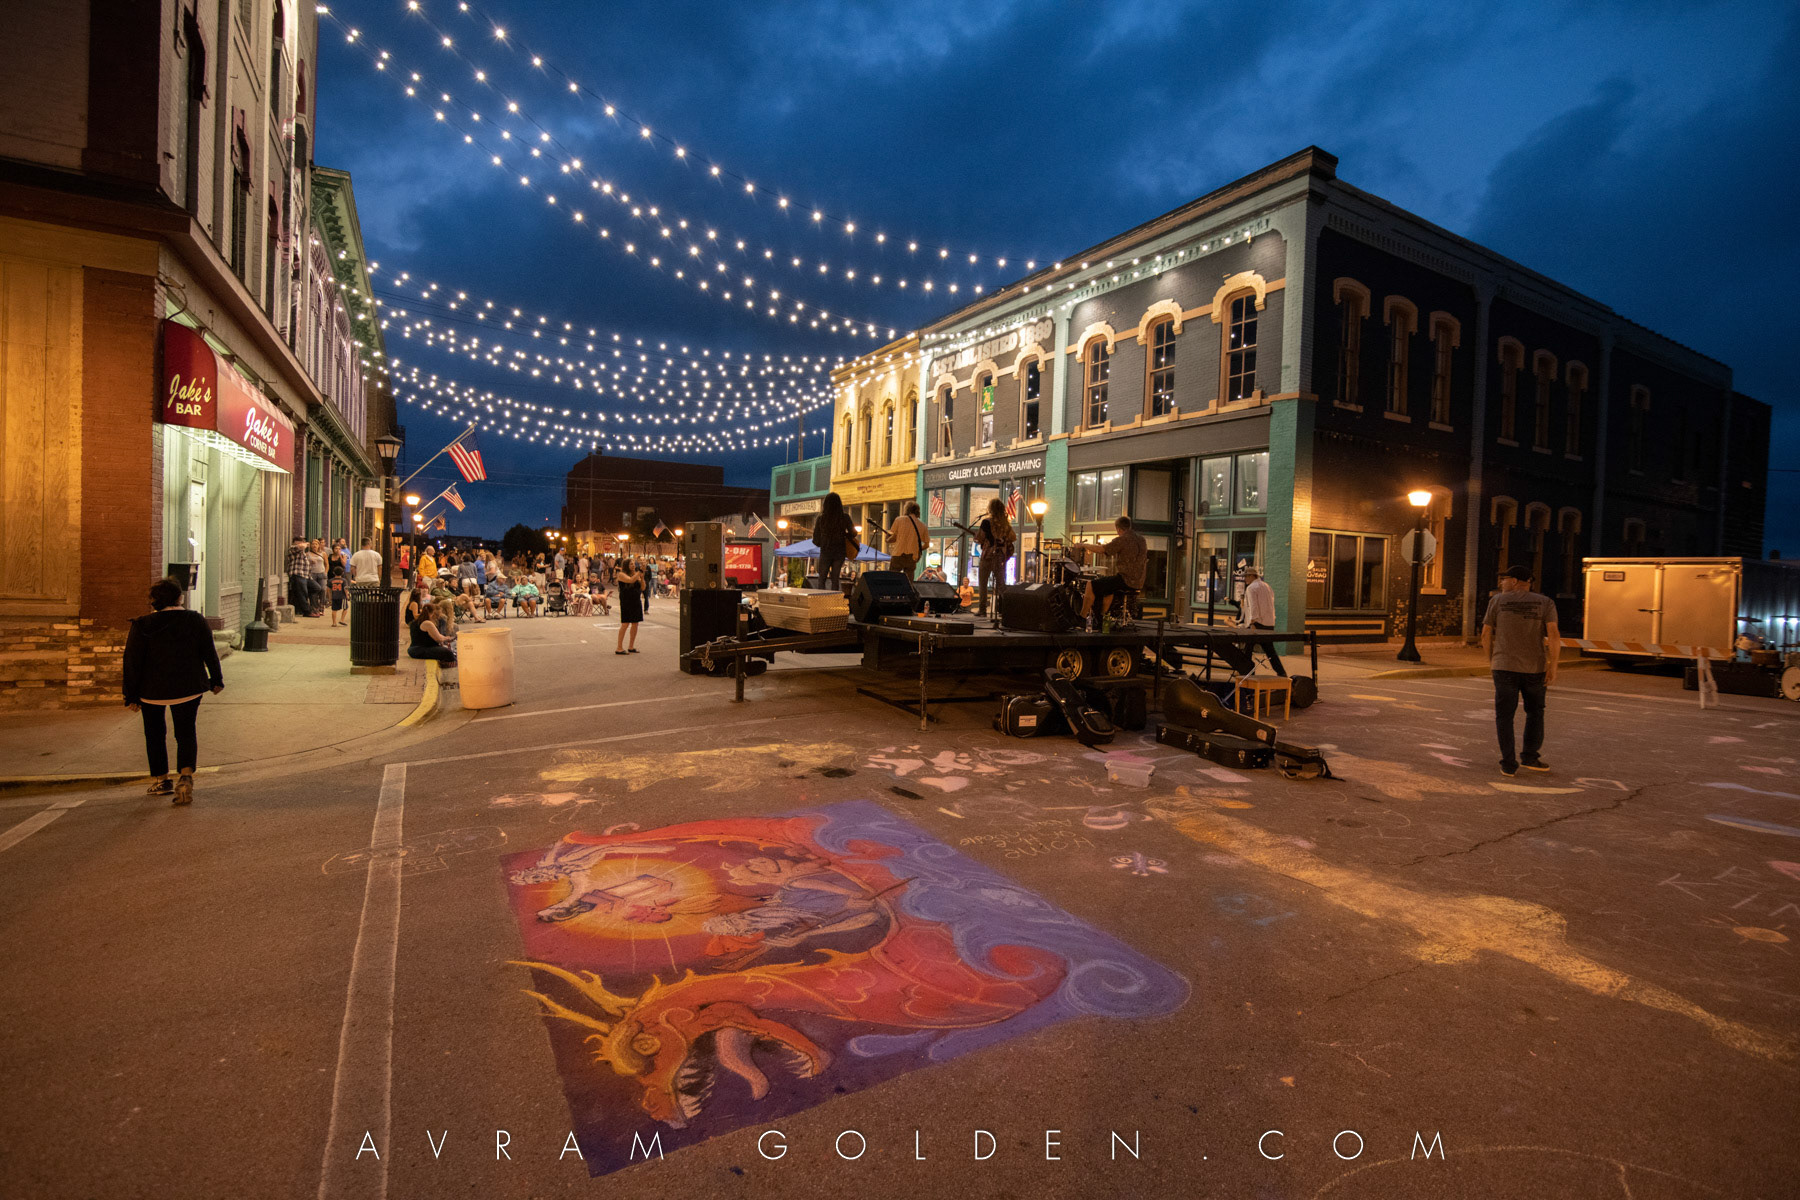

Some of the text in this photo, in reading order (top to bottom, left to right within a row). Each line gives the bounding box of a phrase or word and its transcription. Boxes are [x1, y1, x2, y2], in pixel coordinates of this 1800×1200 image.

[167, 373, 212, 409] Jake's
[175, 402, 202, 416] BAR
[243, 407, 279, 447] Jake's
[250, 436, 276, 459] CORNER BAR
[948, 467, 973, 480] GALLERY
[973, 467, 979, 476] &
[980, 463, 1007, 476] CUSTOM
[1008, 458, 1042, 473] FRAMING
